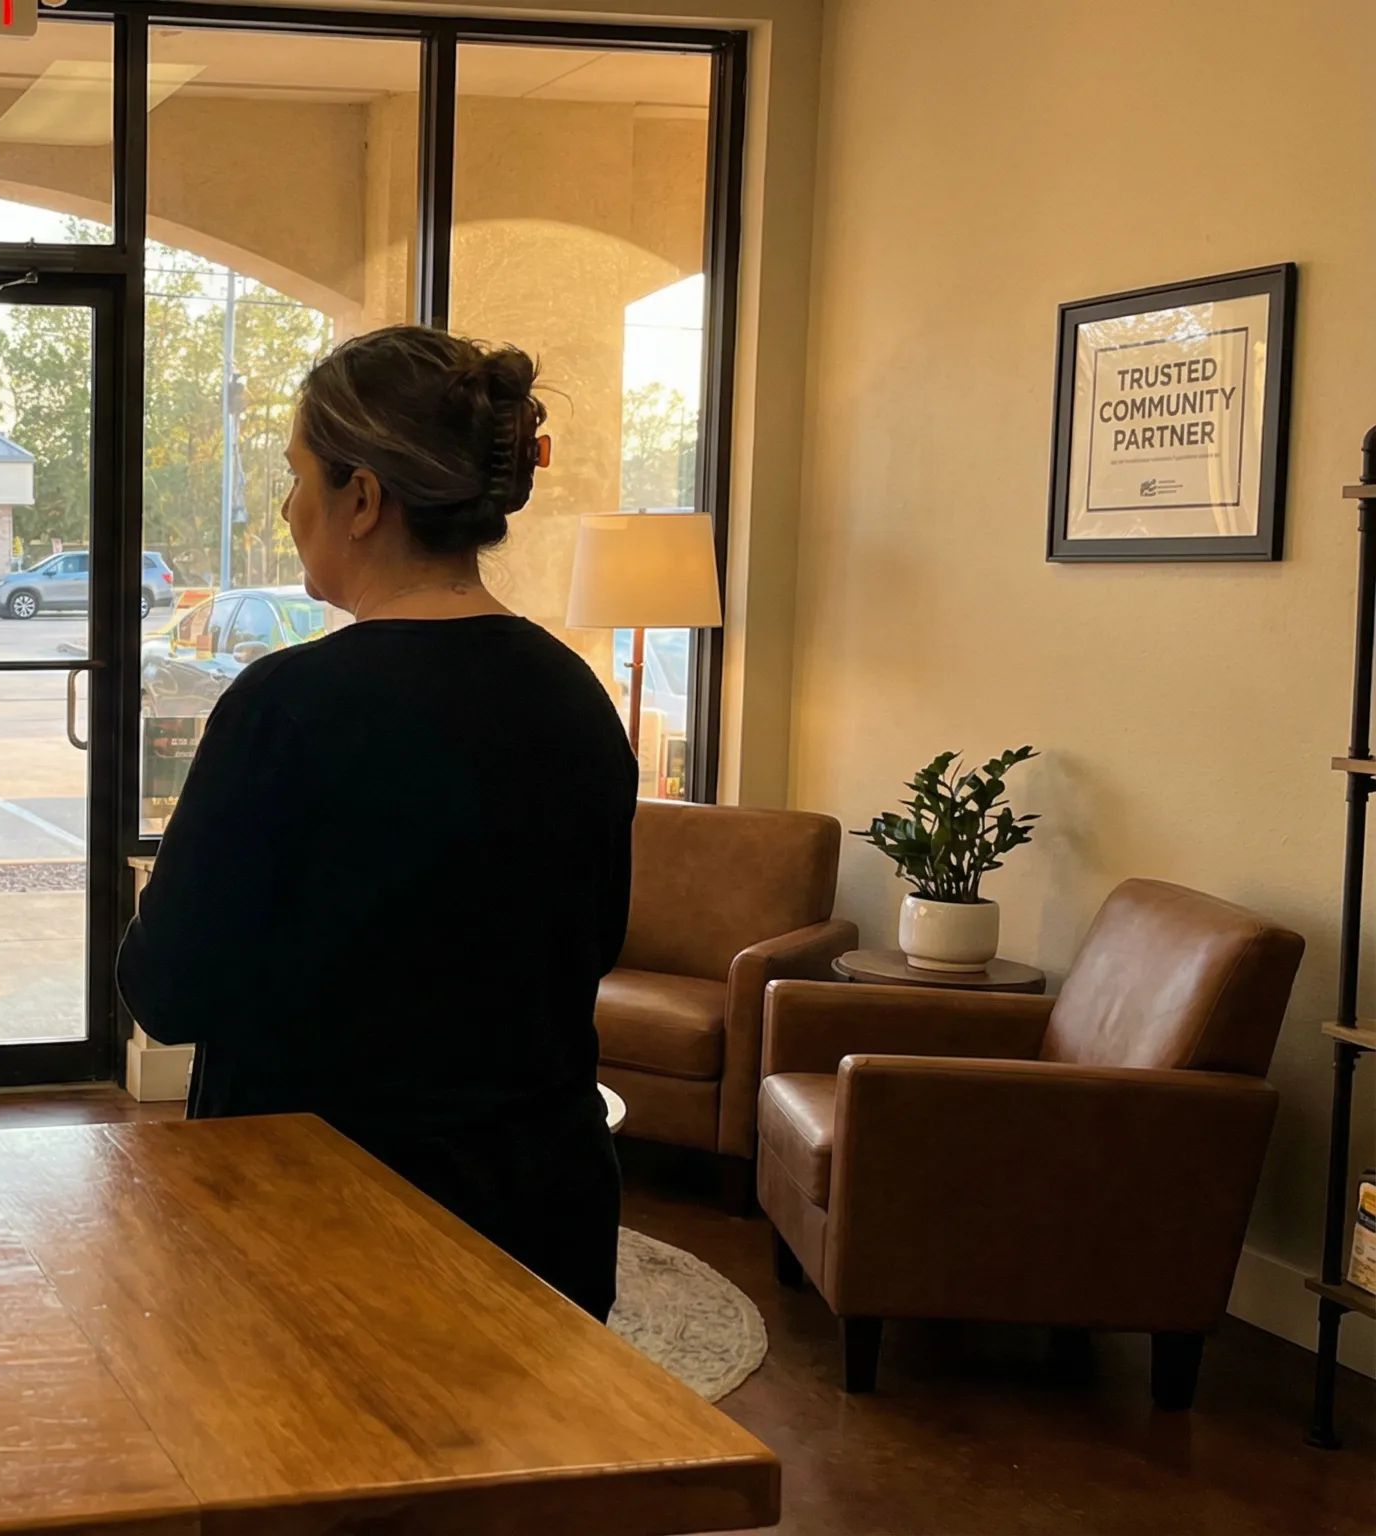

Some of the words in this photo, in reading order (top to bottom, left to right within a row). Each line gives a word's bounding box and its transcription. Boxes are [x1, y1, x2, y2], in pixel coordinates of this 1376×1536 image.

[1117, 357, 1217, 391] TRUSTED
[1099, 386, 1236, 423] COMMUNITY
[1113, 420, 1215, 451] PARTNER
